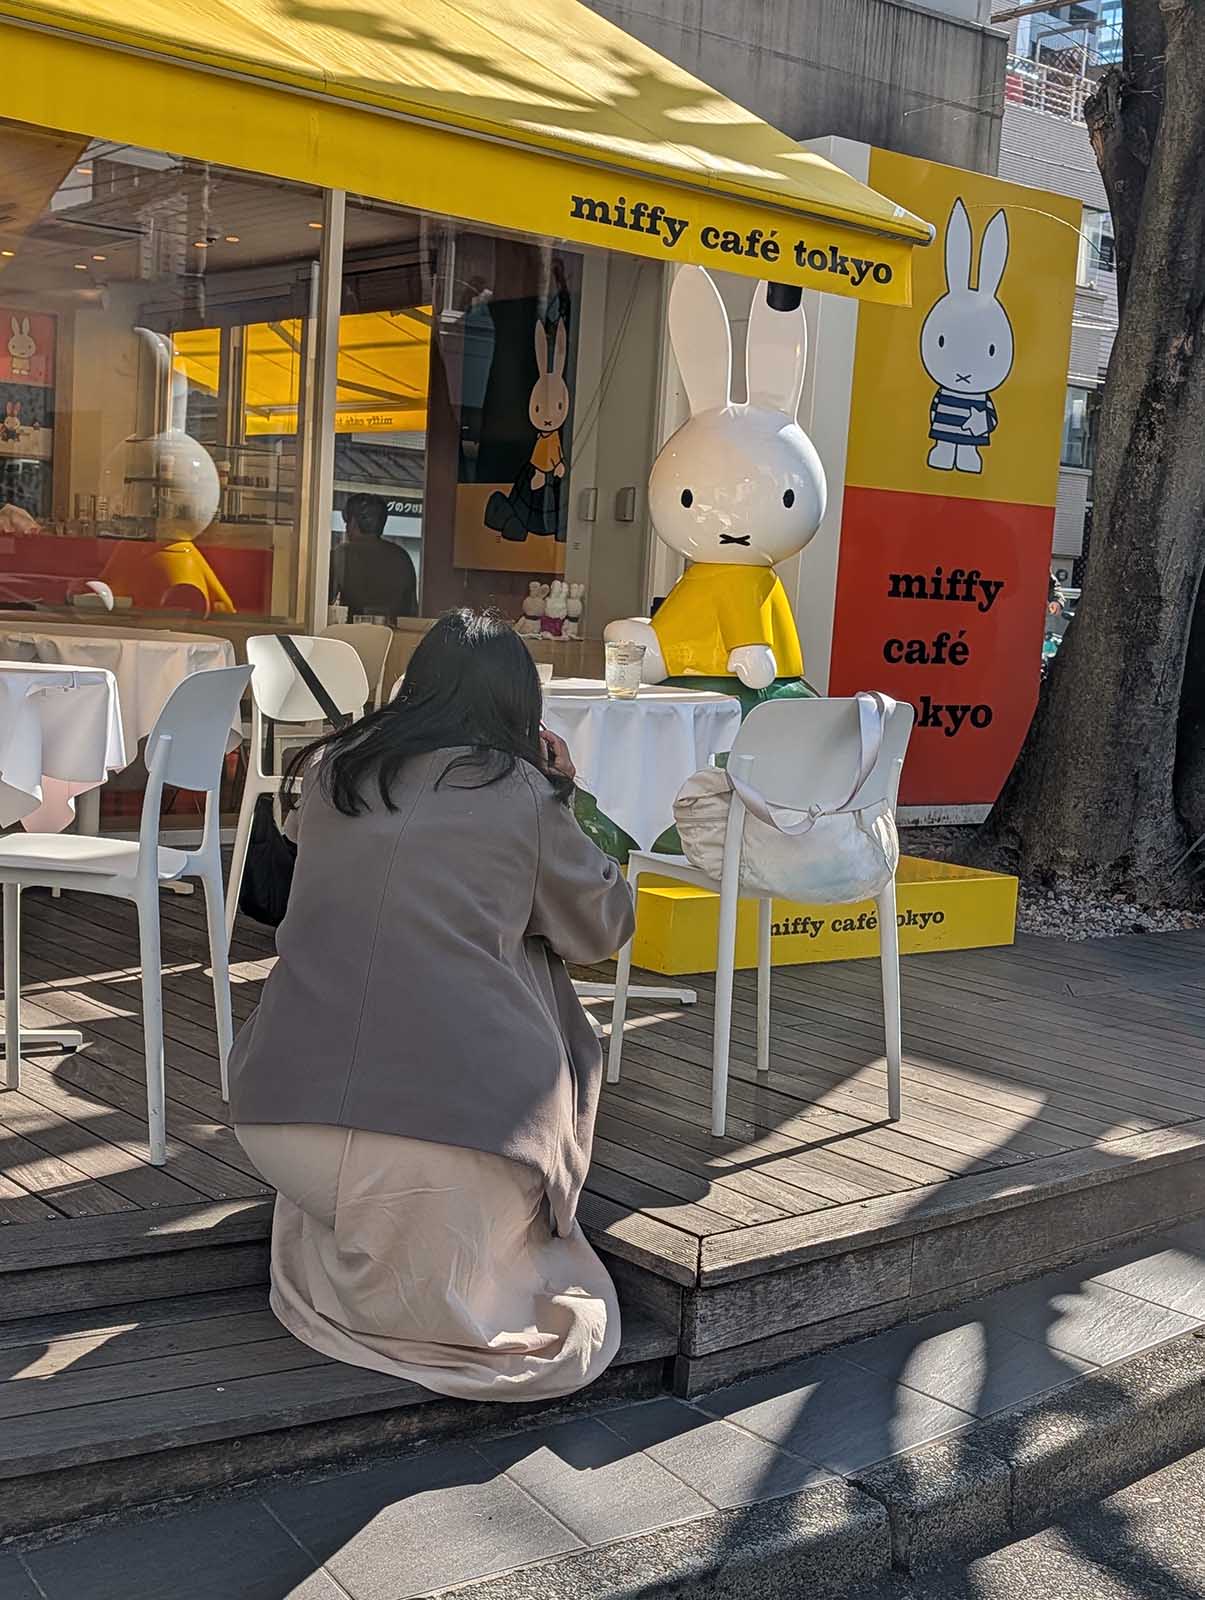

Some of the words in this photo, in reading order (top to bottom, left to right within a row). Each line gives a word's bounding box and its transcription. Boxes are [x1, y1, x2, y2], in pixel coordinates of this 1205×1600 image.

[570, 195, 689, 247] miffy
[700, 225, 780, 263] café
[794, 240, 893, 287] tokyo
[888, 566, 1004, 612] miffy
[883, 630, 969, 665] café
[831, 911, 878, 932] café
[896, 910, 945, 929] okyo
